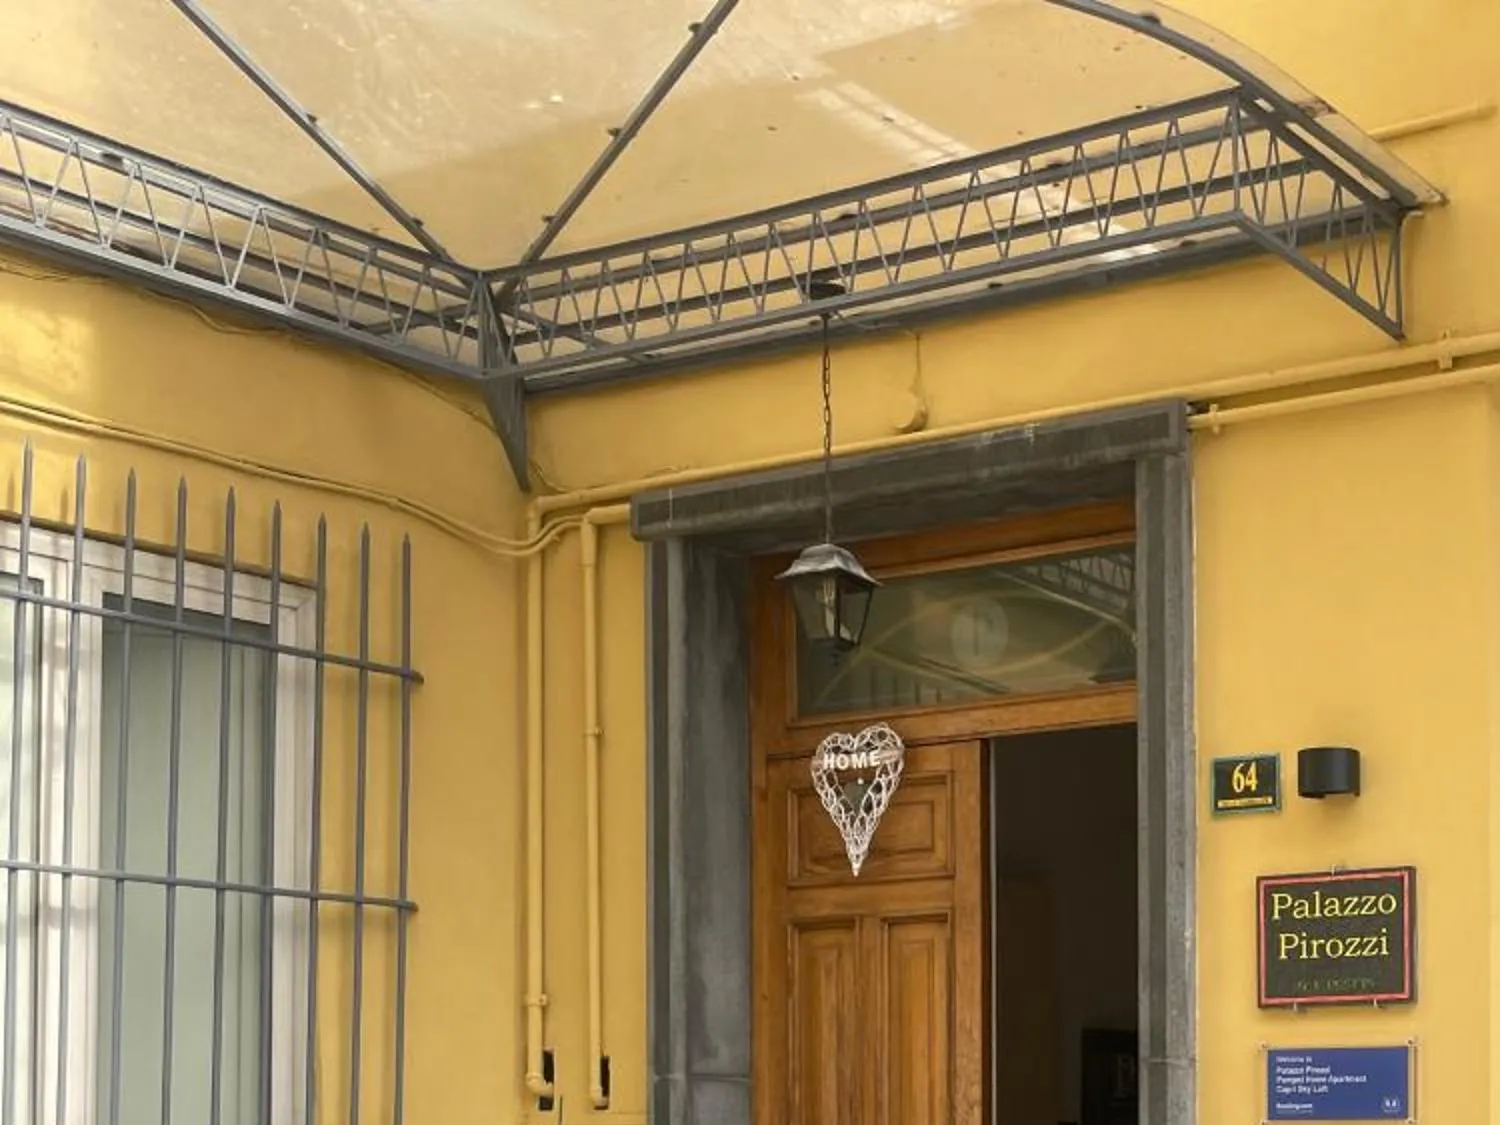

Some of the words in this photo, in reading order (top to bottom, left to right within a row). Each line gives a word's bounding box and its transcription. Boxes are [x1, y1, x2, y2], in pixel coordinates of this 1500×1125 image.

[823, 751, 880, 769] HOME
[1232, 762, 1258, 792] 64
[1271, 891, 1397, 920] Palazzo
[1279, 928, 1389, 960] Pirozzi
